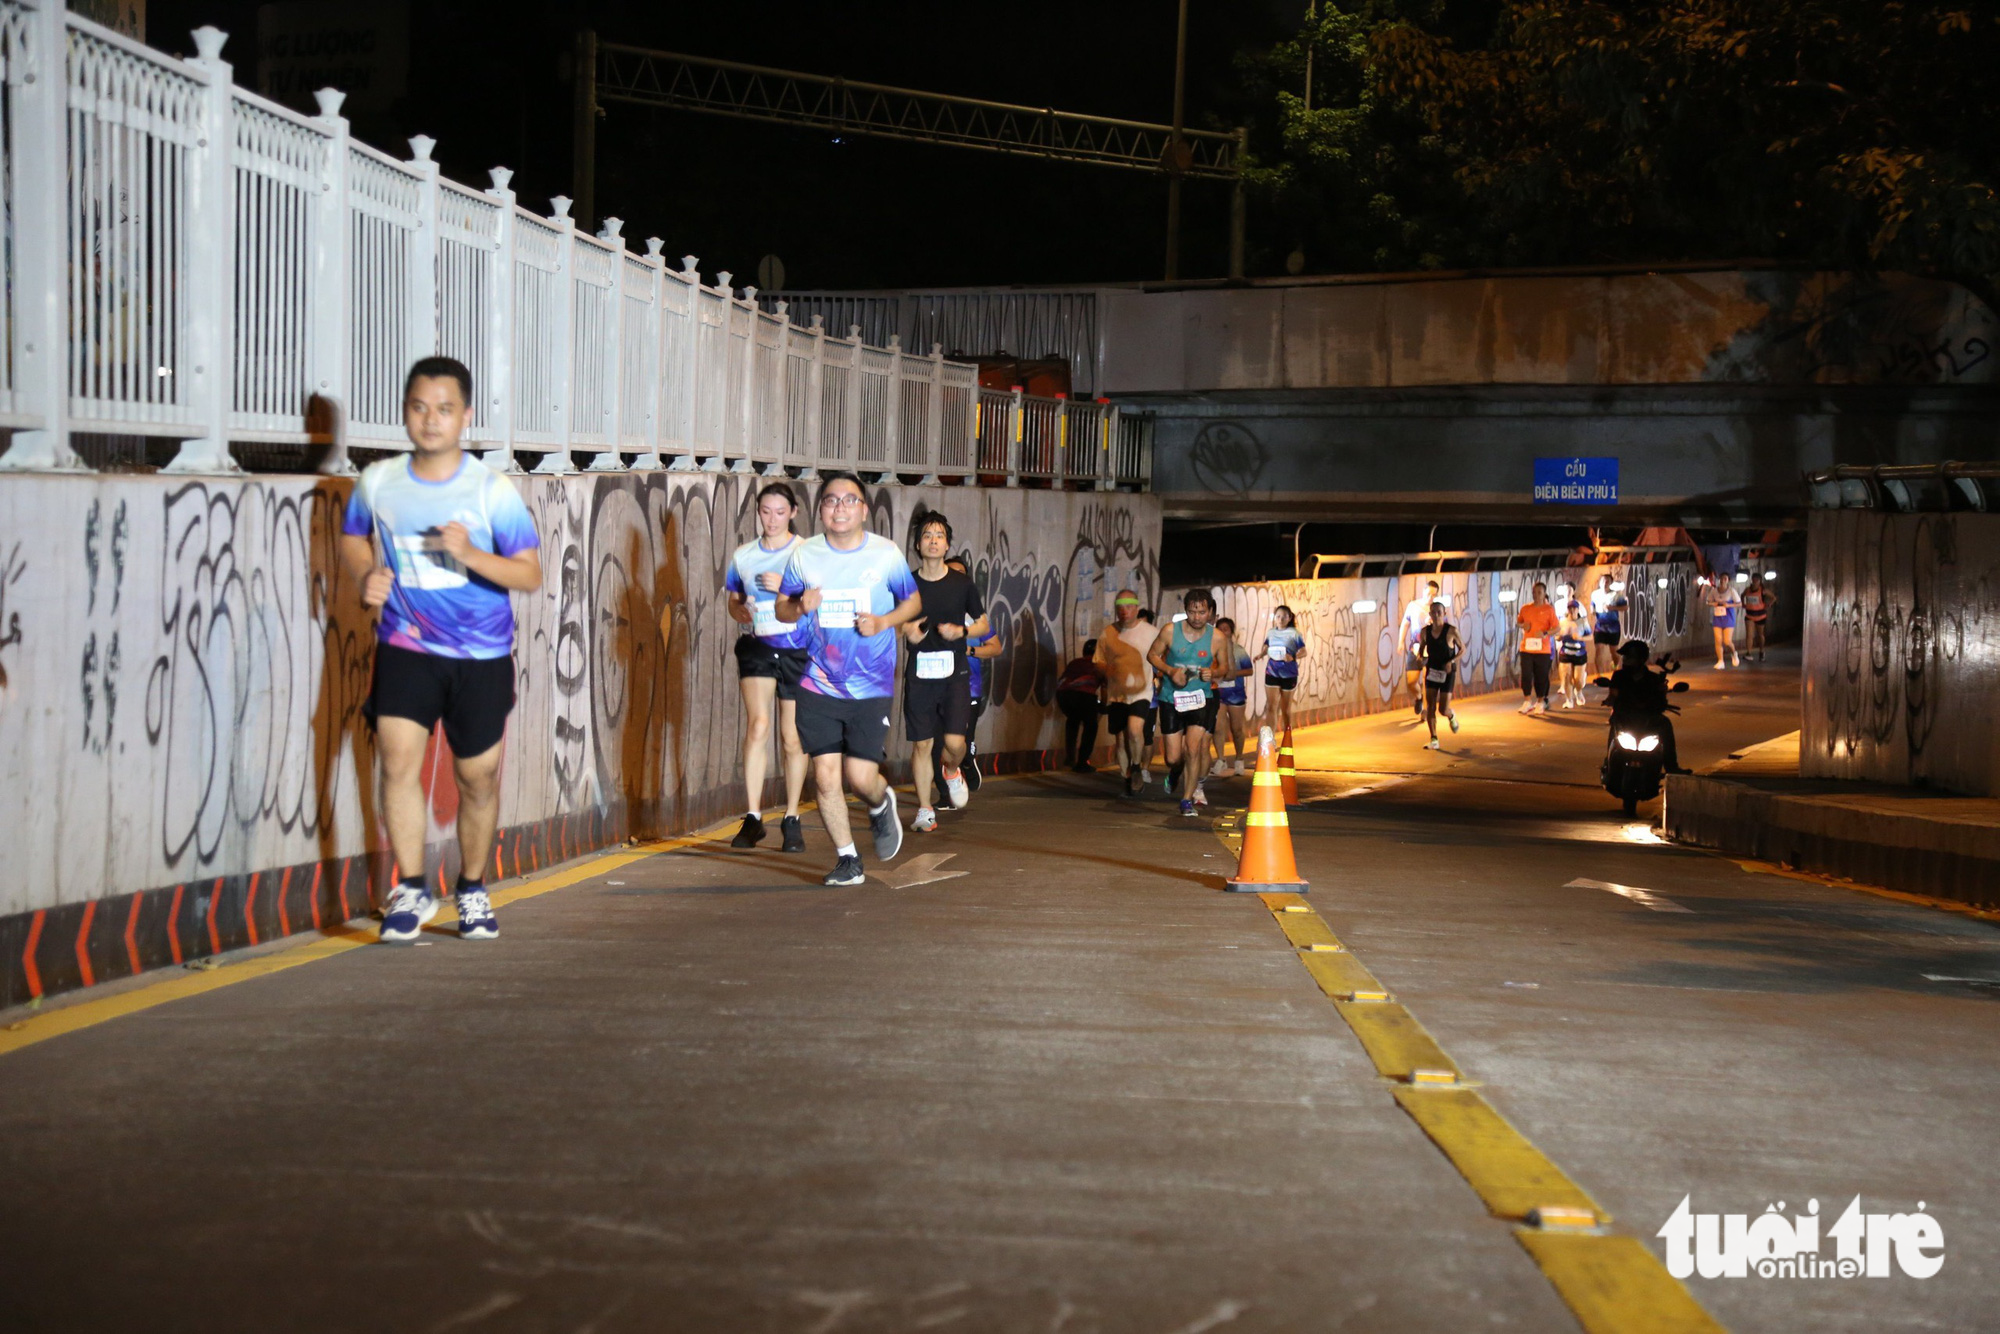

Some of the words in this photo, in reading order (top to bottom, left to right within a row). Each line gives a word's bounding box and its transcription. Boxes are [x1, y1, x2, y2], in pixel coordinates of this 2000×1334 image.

[1534, 481, 1559, 502] ĐIỆN
[1561, 481, 1585, 499] BIÊN
[1587, 479, 1608, 499] PHỦ
[1610, 485, 1617, 499] 1
